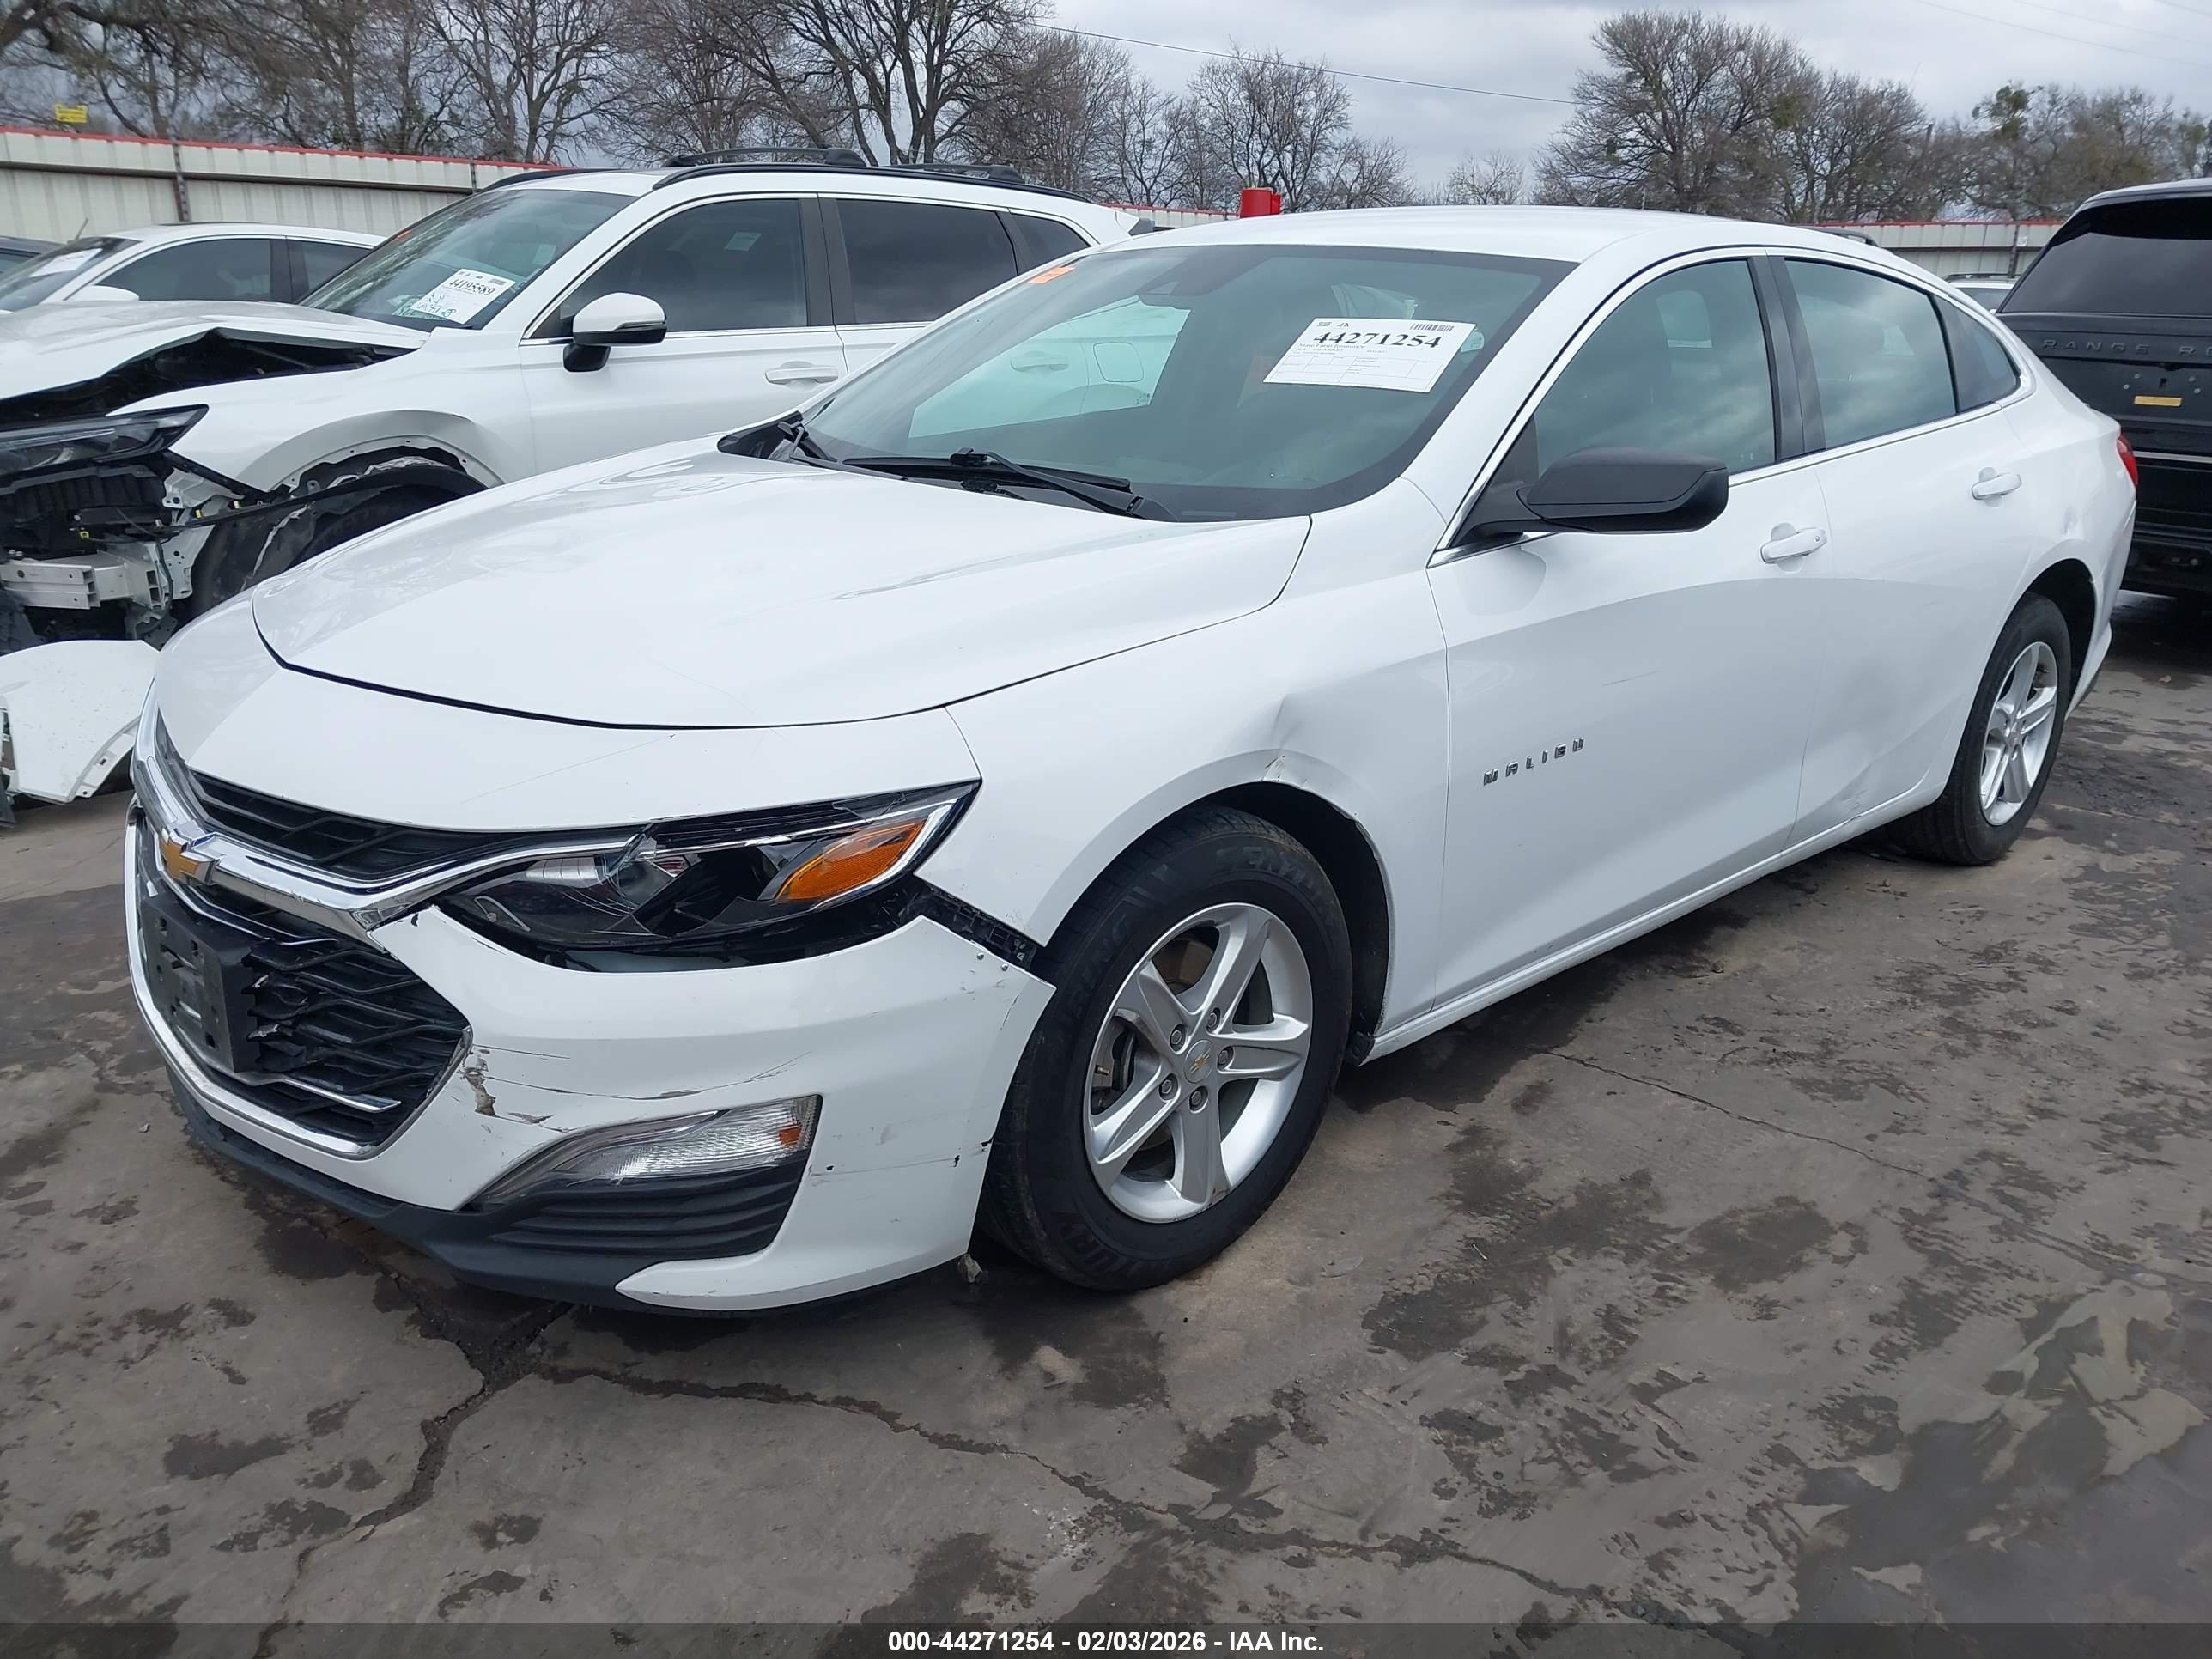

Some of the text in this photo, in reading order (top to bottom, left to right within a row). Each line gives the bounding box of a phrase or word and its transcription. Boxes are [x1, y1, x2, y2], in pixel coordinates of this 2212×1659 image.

[1313, 331, 1443, 349] 44271254
[2043, 339, 2150, 355] RANGE
[1484, 737, 1584, 786] MALIBU
